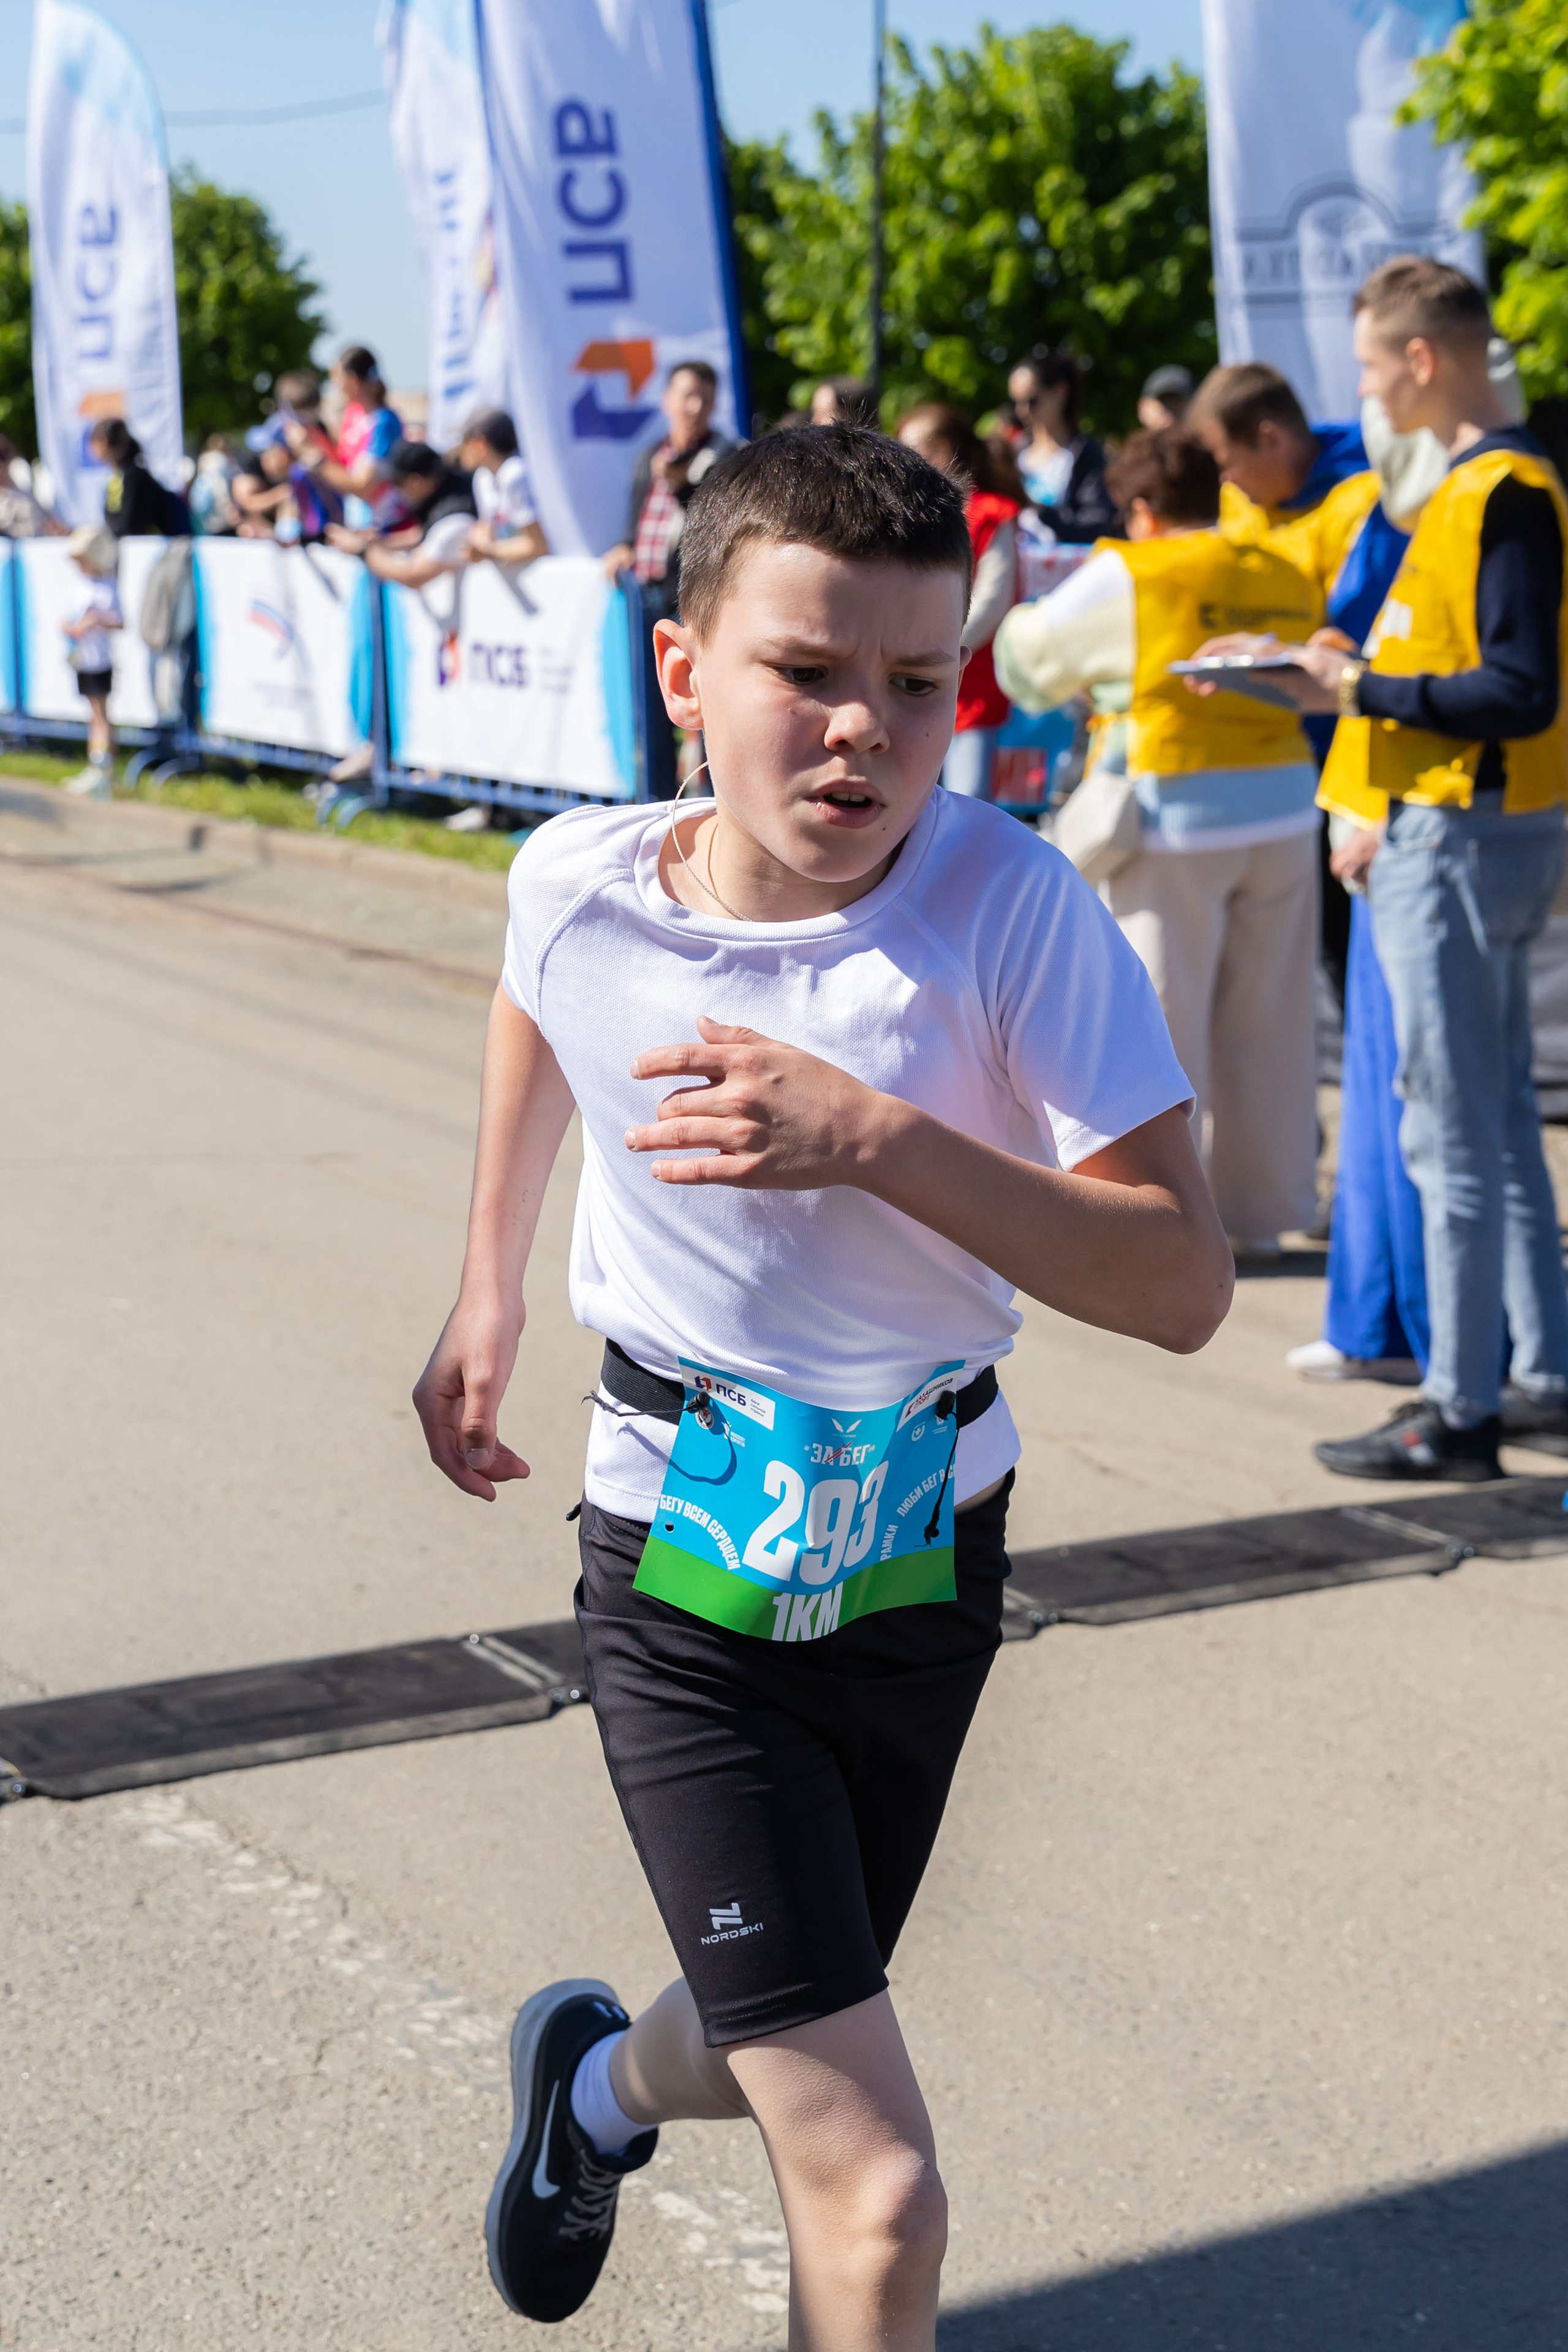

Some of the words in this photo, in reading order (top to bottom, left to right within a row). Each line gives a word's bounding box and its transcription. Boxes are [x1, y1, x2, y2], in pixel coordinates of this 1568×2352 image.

[716, 1383, 746, 1406] ПСБ
[916, 1378, 954, 1403] КАЛАШНИКОВ
[896, 1485, 924, 1517] ЛЮБИ
[922, 1472, 938, 1493] БЕГ
[659, 1493, 685, 1513] БЕГУ
[682, 1501, 712, 1528] ВСЕМ
[707, 1519, 741, 1570] СЕРДЦЕМ
[742, 1460, 889, 1585] 293
[880, 1524, 899, 1561] РАМКИ
[700, 1922, 764, 1945] NORDSKI
